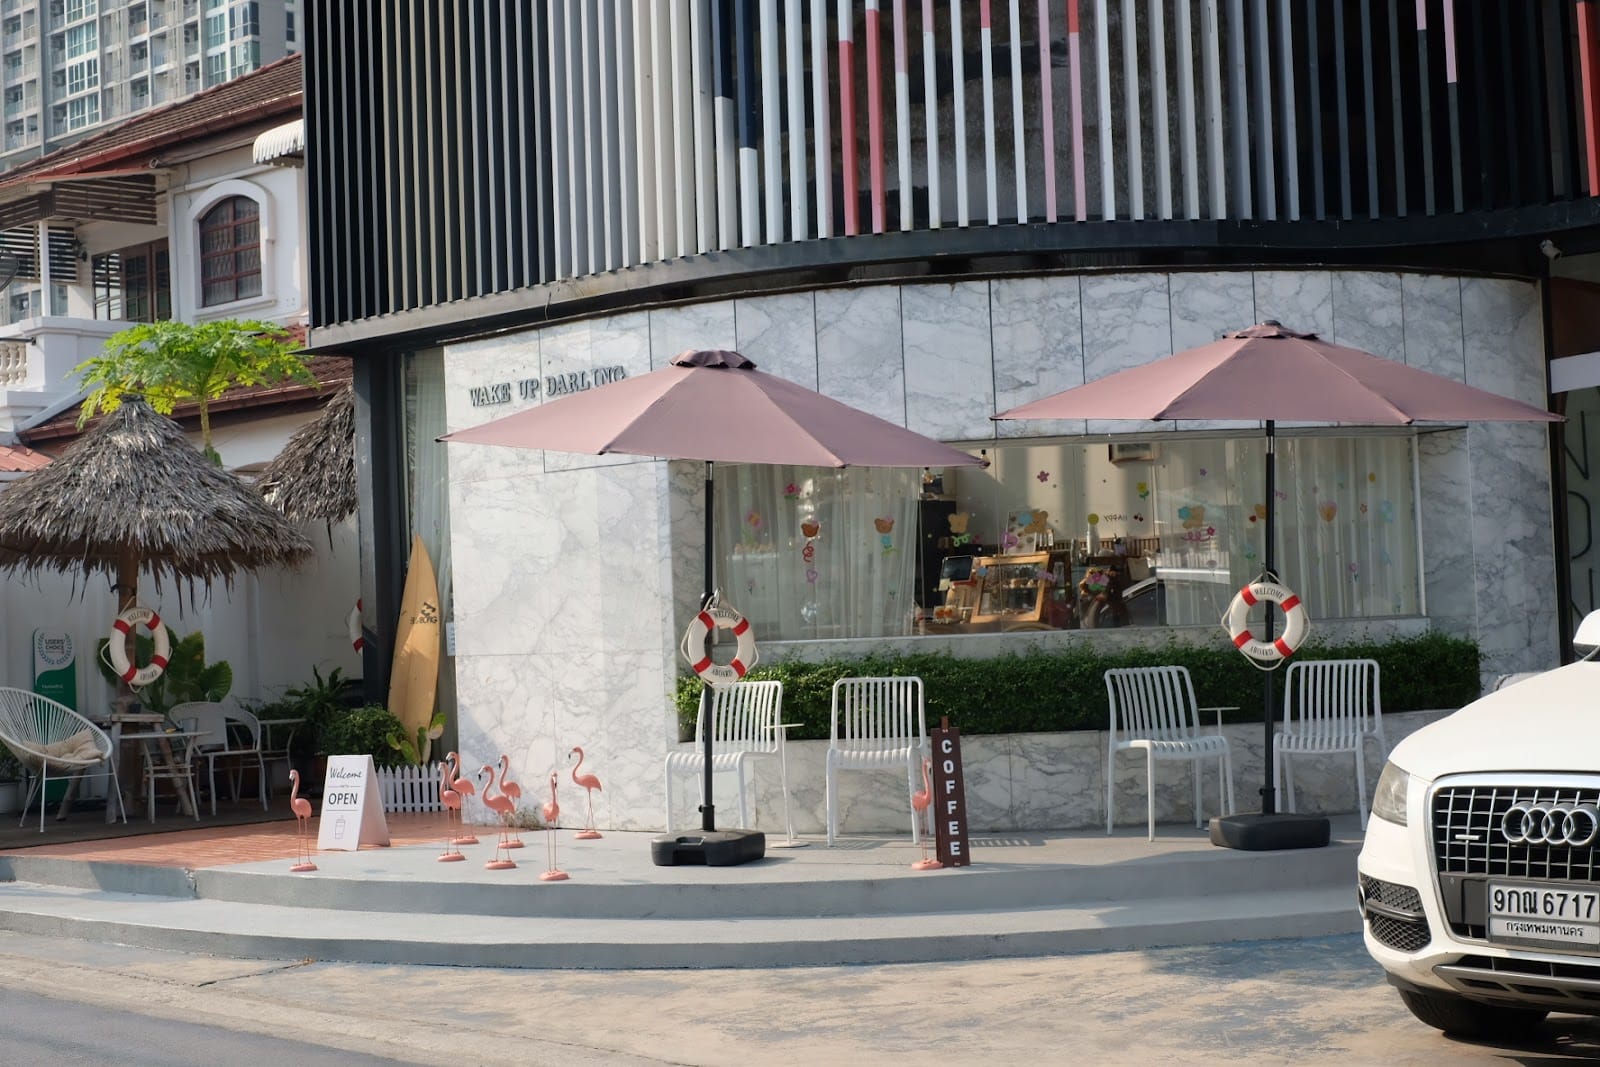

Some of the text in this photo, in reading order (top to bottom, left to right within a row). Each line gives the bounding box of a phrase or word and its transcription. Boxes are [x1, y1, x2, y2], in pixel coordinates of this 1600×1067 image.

[470, 383, 512, 407] WAKE
[518, 379, 540, 400] UP
[1254, 587, 1285, 600] WELCOME
[329, 766, 363, 779] Welcome
[328, 793, 358, 805] OPEN
[941, 739, 961, 856] COFFEE
[1543, 892, 1596, 918] 6717
[1506, 920, 1584, 937] กรุงเทพมหานคร
